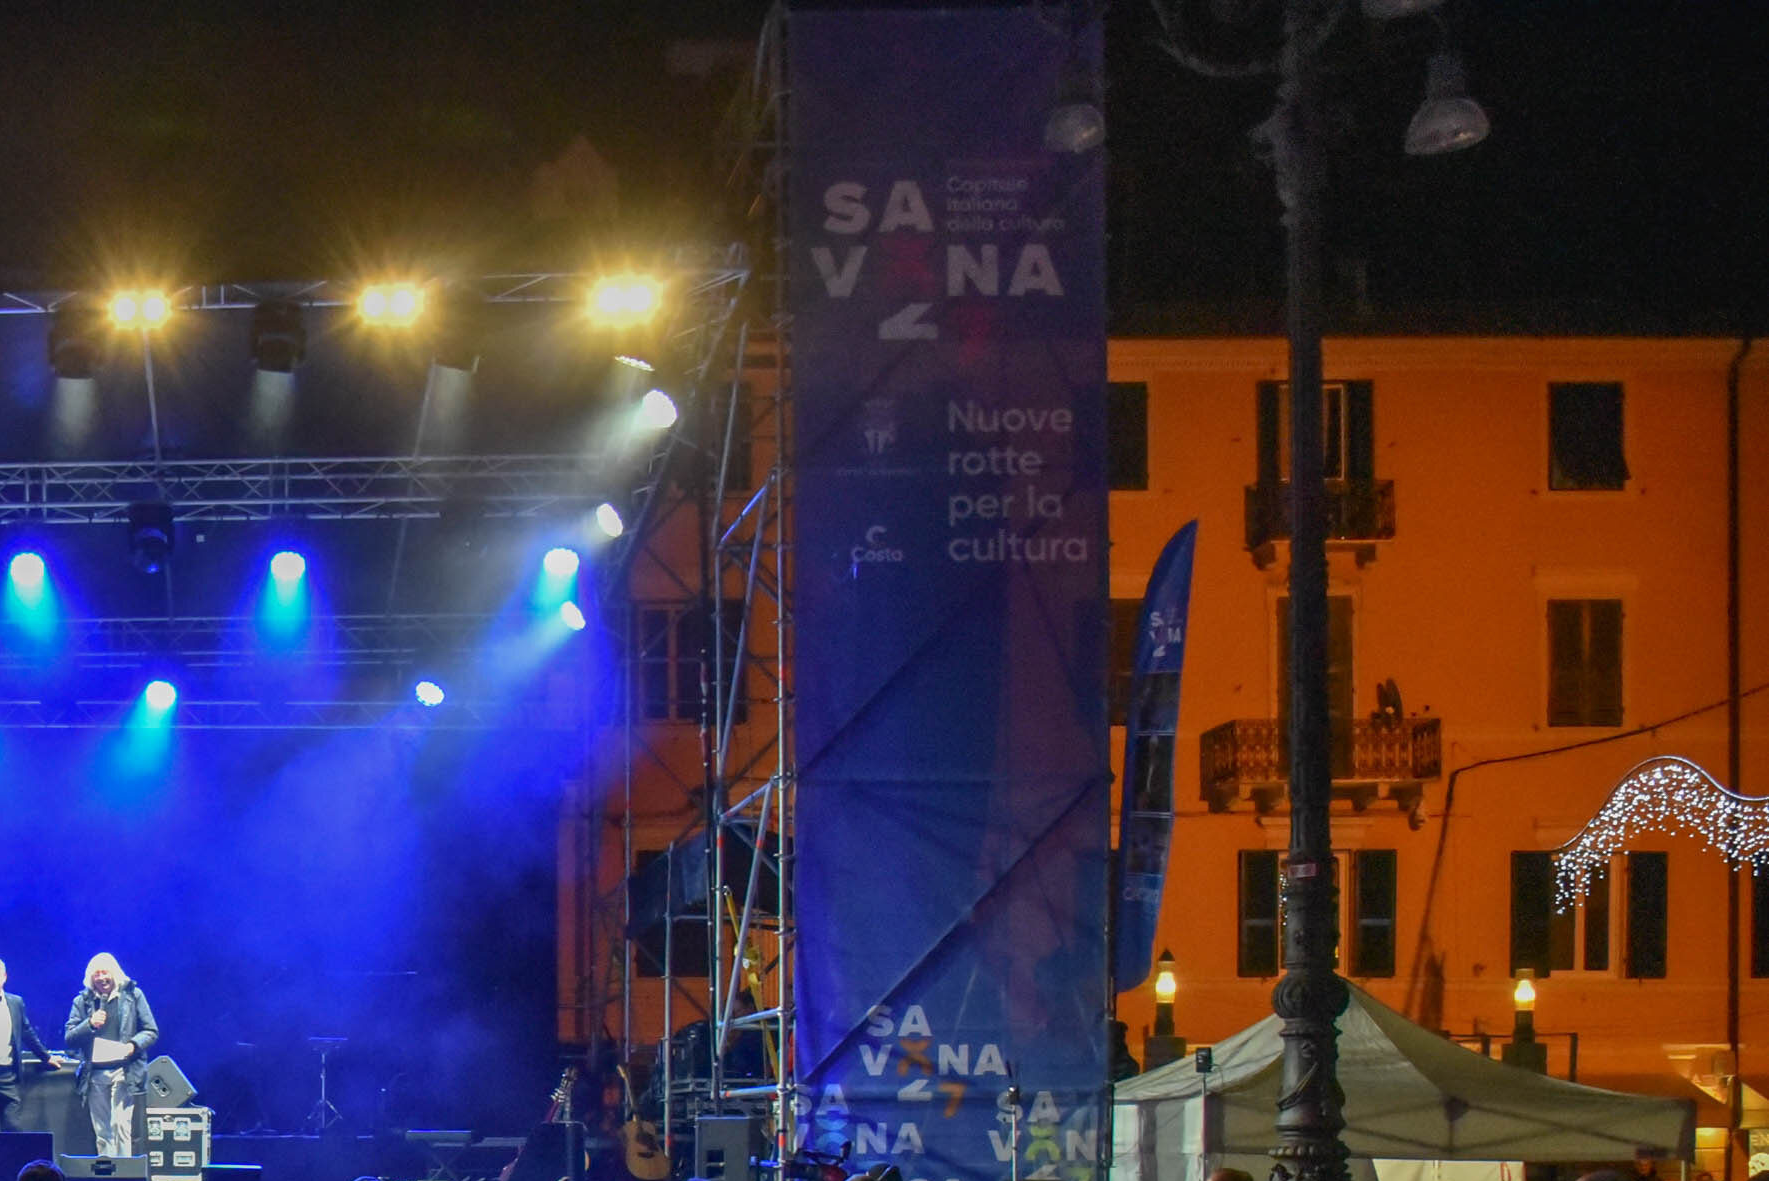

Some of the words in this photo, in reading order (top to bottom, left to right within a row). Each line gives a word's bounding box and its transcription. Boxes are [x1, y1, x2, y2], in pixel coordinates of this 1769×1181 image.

[823, 179, 936, 235] SA
[947, 399, 1074, 433] Nuove
[947, 446, 1044, 476] rotte
[947, 492, 1015, 528] per
[1027, 485, 1064, 519] la
[850, 546, 905, 563] Costa
[947, 527, 1088, 563] cultura
[866, 1004, 933, 1037] SA
[994, 1090, 1061, 1123] SA
